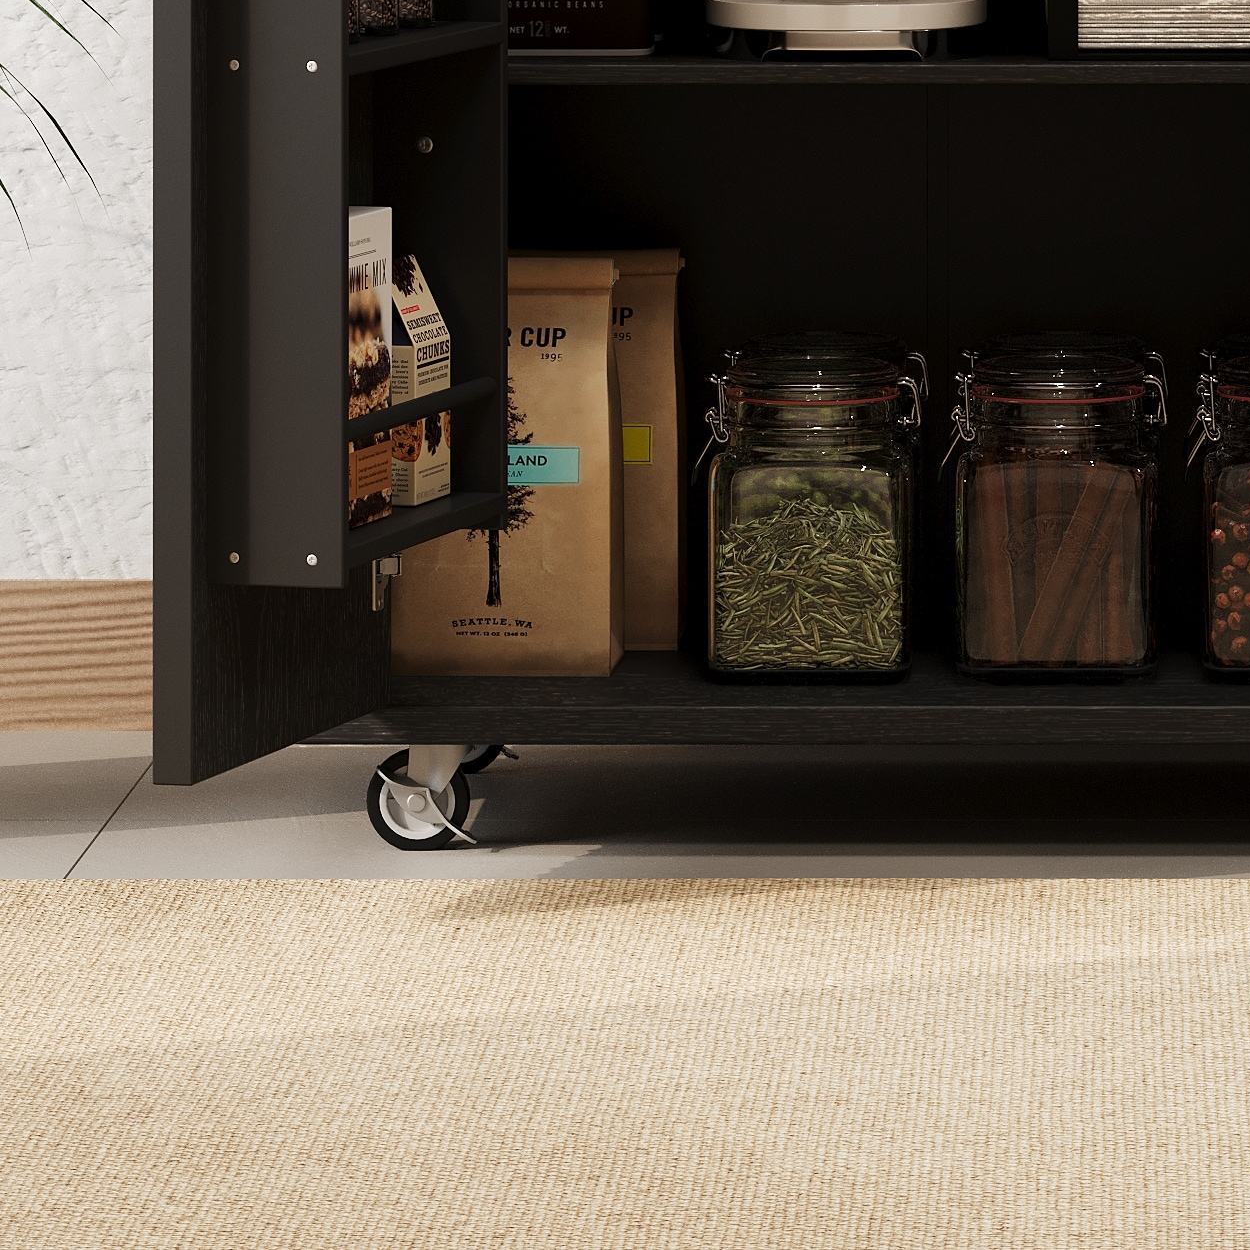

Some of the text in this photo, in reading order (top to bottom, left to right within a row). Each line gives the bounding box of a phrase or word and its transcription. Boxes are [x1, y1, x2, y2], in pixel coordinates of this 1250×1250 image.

[566, 0, 604, 9] BEANS
[510, 26, 525, 34] NET
[553, 26, 571, 34] WT.
[349, 258, 387, 294] WNIE MIX
[406, 312, 442, 331] SEMISWEET
[412, 325, 449, 344] CHOCOLATE
[520, 327, 567, 348] CUP
[613, 332, 632, 342] 995
[416, 339, 451, 363] CHUNKS
[540, 352, 563, 363] 1995
[507, 455, 548, 467] LAND
[515, 619, 532, 629] WA
